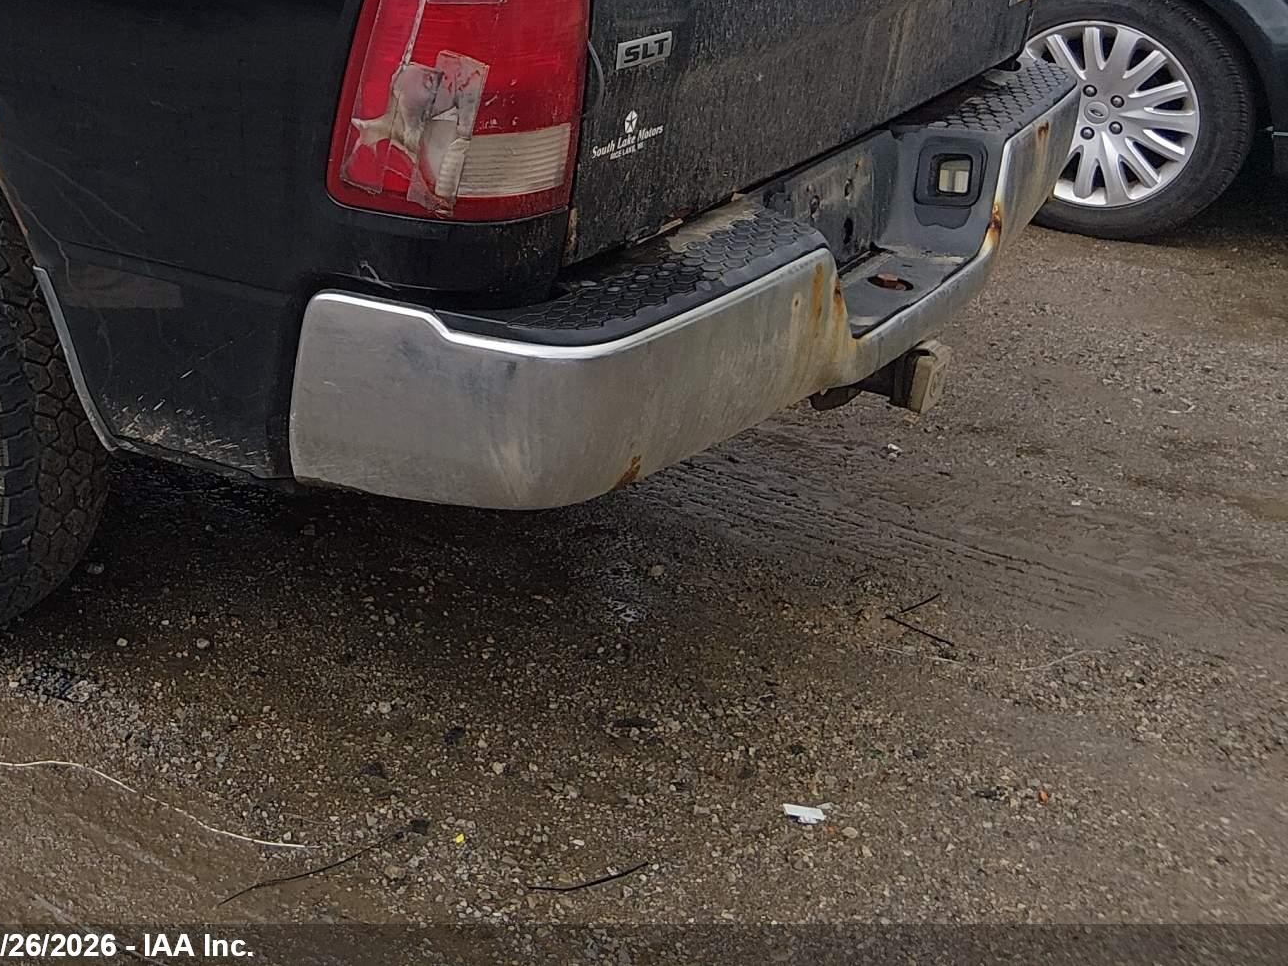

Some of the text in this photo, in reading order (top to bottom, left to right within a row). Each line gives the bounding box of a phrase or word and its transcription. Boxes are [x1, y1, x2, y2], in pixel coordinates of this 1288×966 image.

[623, 37, 669, 64] SLT
[592, 124, 664, 159] South Lake Motors
